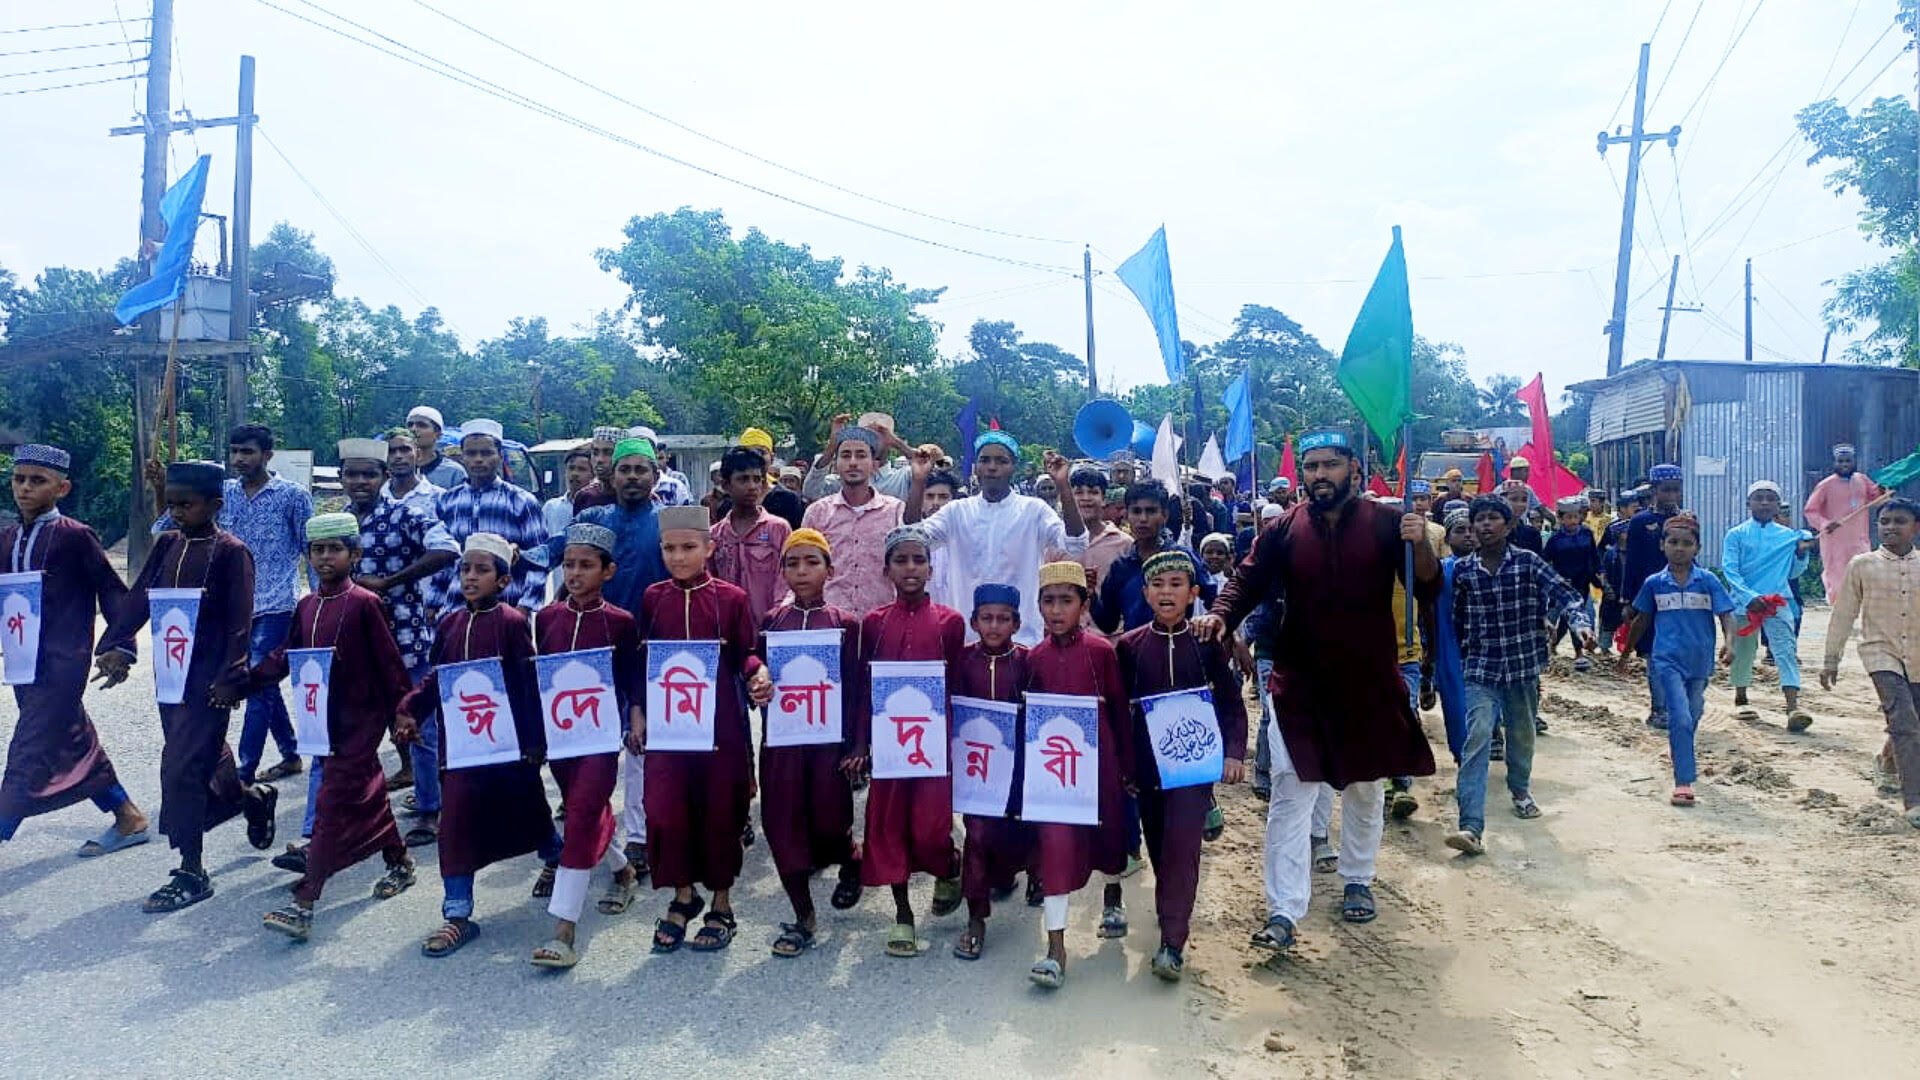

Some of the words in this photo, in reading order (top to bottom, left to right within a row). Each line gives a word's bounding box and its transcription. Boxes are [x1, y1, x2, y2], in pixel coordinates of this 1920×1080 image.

[8, 611, 26, 647] প
[164, 625, 189, 669] বি
[459, 691, 499, 744] ঈ
[551, 687, 606, 730] দে
[659, 666, 709, 725] মি
[779, 681, 833, 727] লা
[889, 716, 932, 769] দু
[966, 740, 994, 783] ন্ন
[1040, 735, 1083, 788] বী
